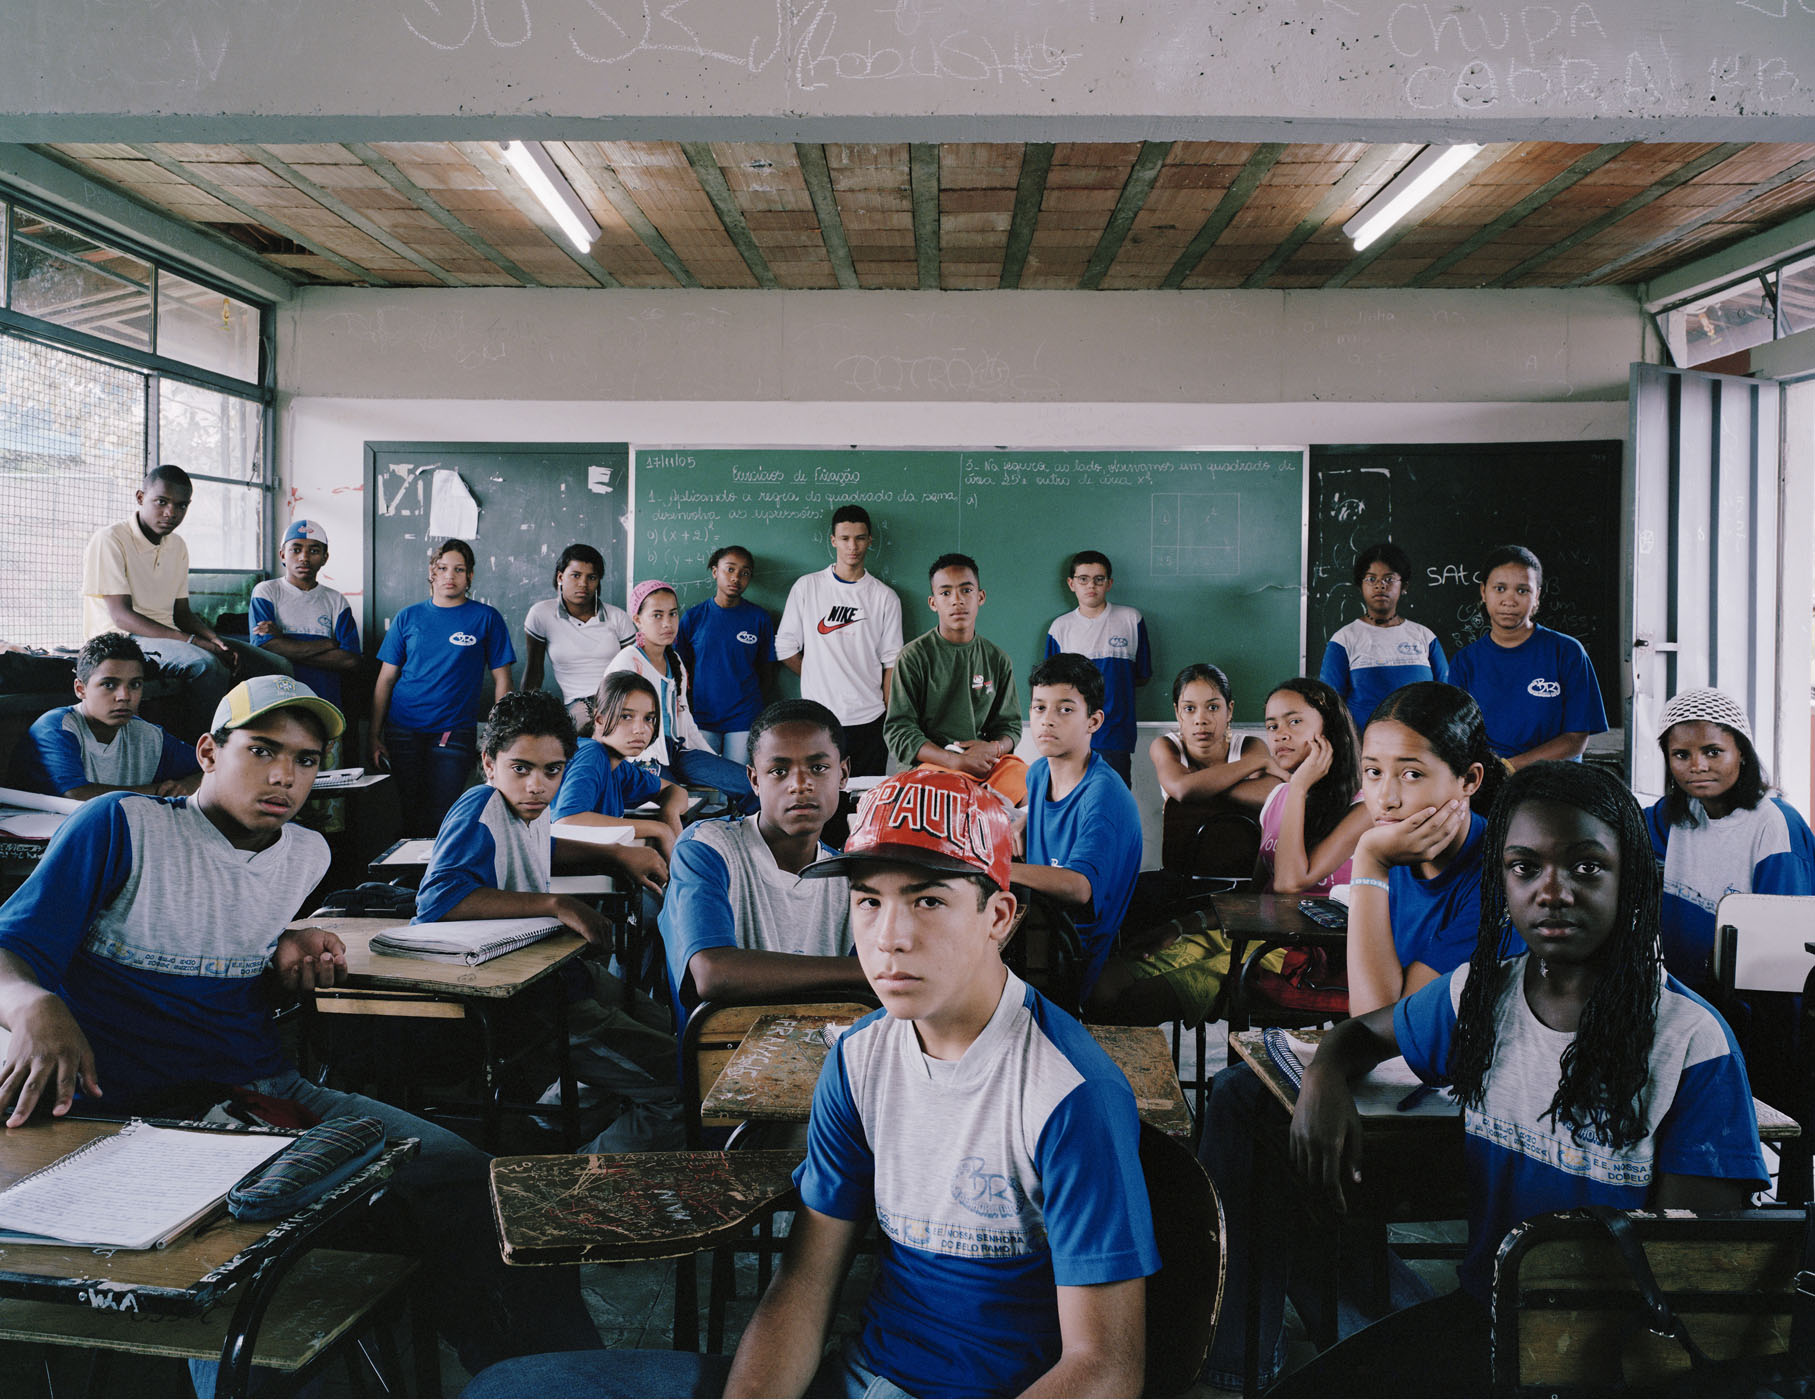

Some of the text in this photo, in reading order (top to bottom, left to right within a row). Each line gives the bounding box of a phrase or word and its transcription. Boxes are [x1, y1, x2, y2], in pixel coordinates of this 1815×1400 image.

[824, 490, 894, 509] quadrado
[828, 606, 858, 624] NIKE
[1613, 1164, 1646, 1174] NOSSA
[976, 1233, 1025, 1244] SENHORA
